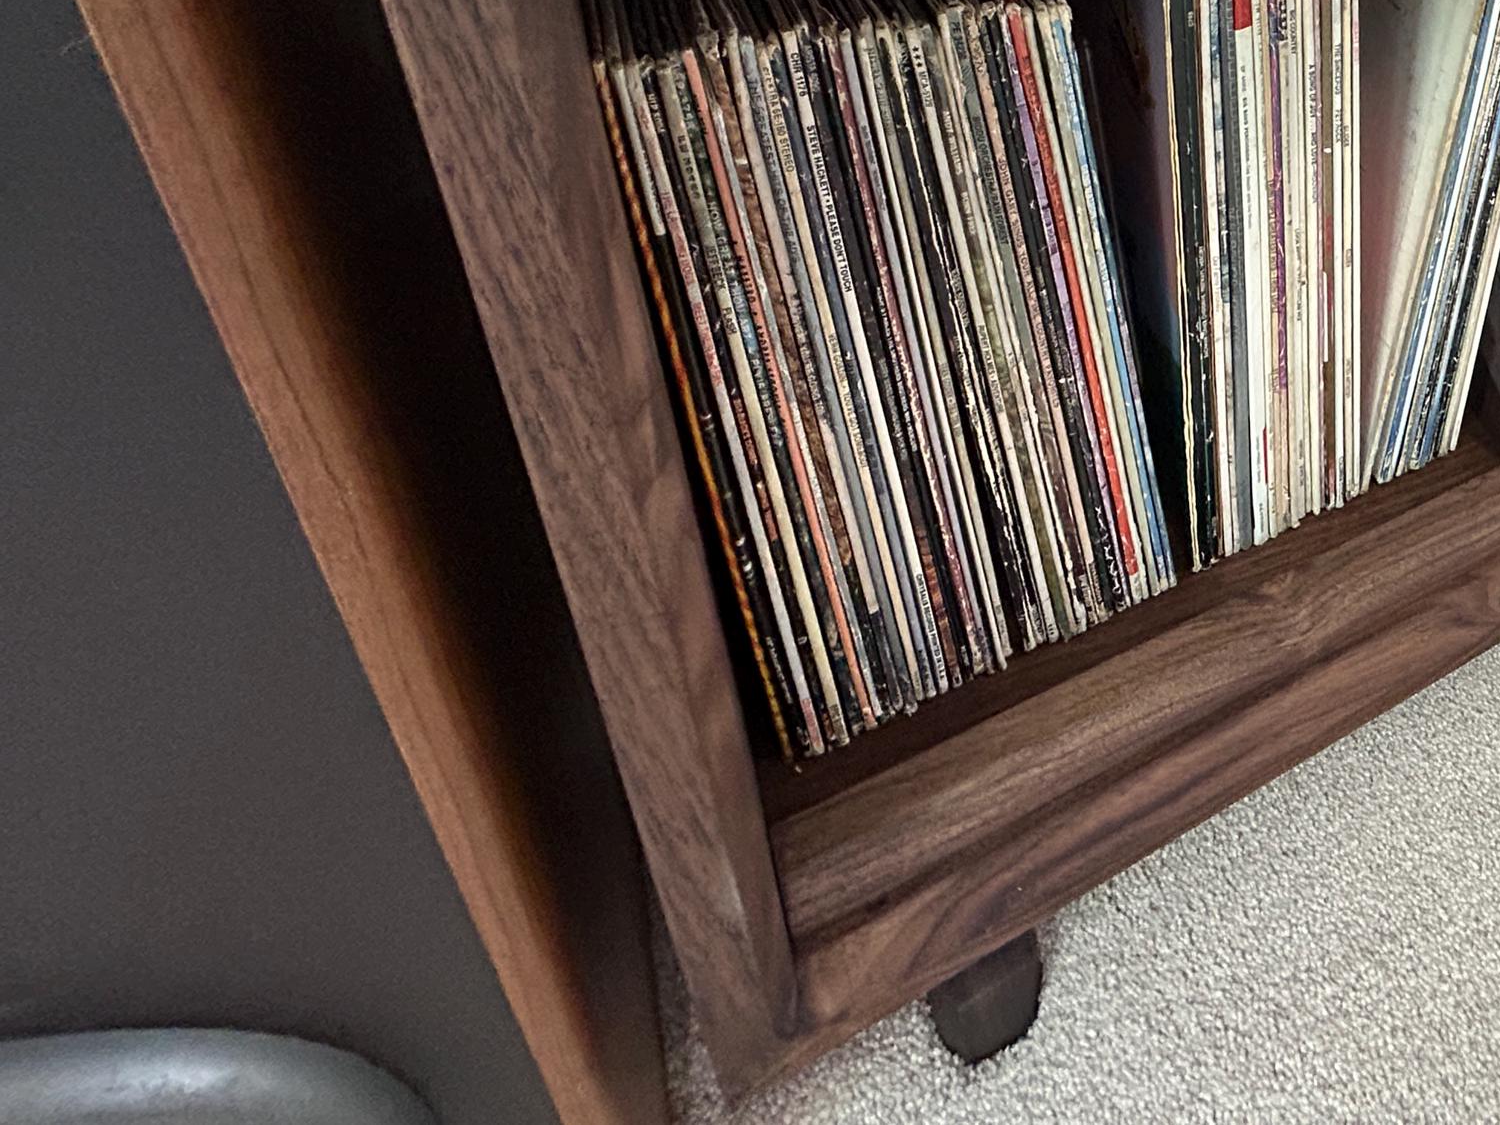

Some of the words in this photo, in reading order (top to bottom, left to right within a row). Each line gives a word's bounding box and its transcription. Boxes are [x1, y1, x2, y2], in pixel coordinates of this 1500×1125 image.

[790, 52, 803, 73] CHR
[807, 125, 821, 154] STEVE
[779, 138, 795, 173] STEREO
[812, 155, 831, 197] HACKETT
[999, 157, 1011, 185] JOHN
[1004, 189, 1018, 214] GARY
[825, 204, 840, 240] PLEASE
[834, 238, 847, 264] DON'T
[839, 263, 853, 293] TOUCH
[709, 263, 726, 290] BECK
[721, 307, 738, 335] FLASH
